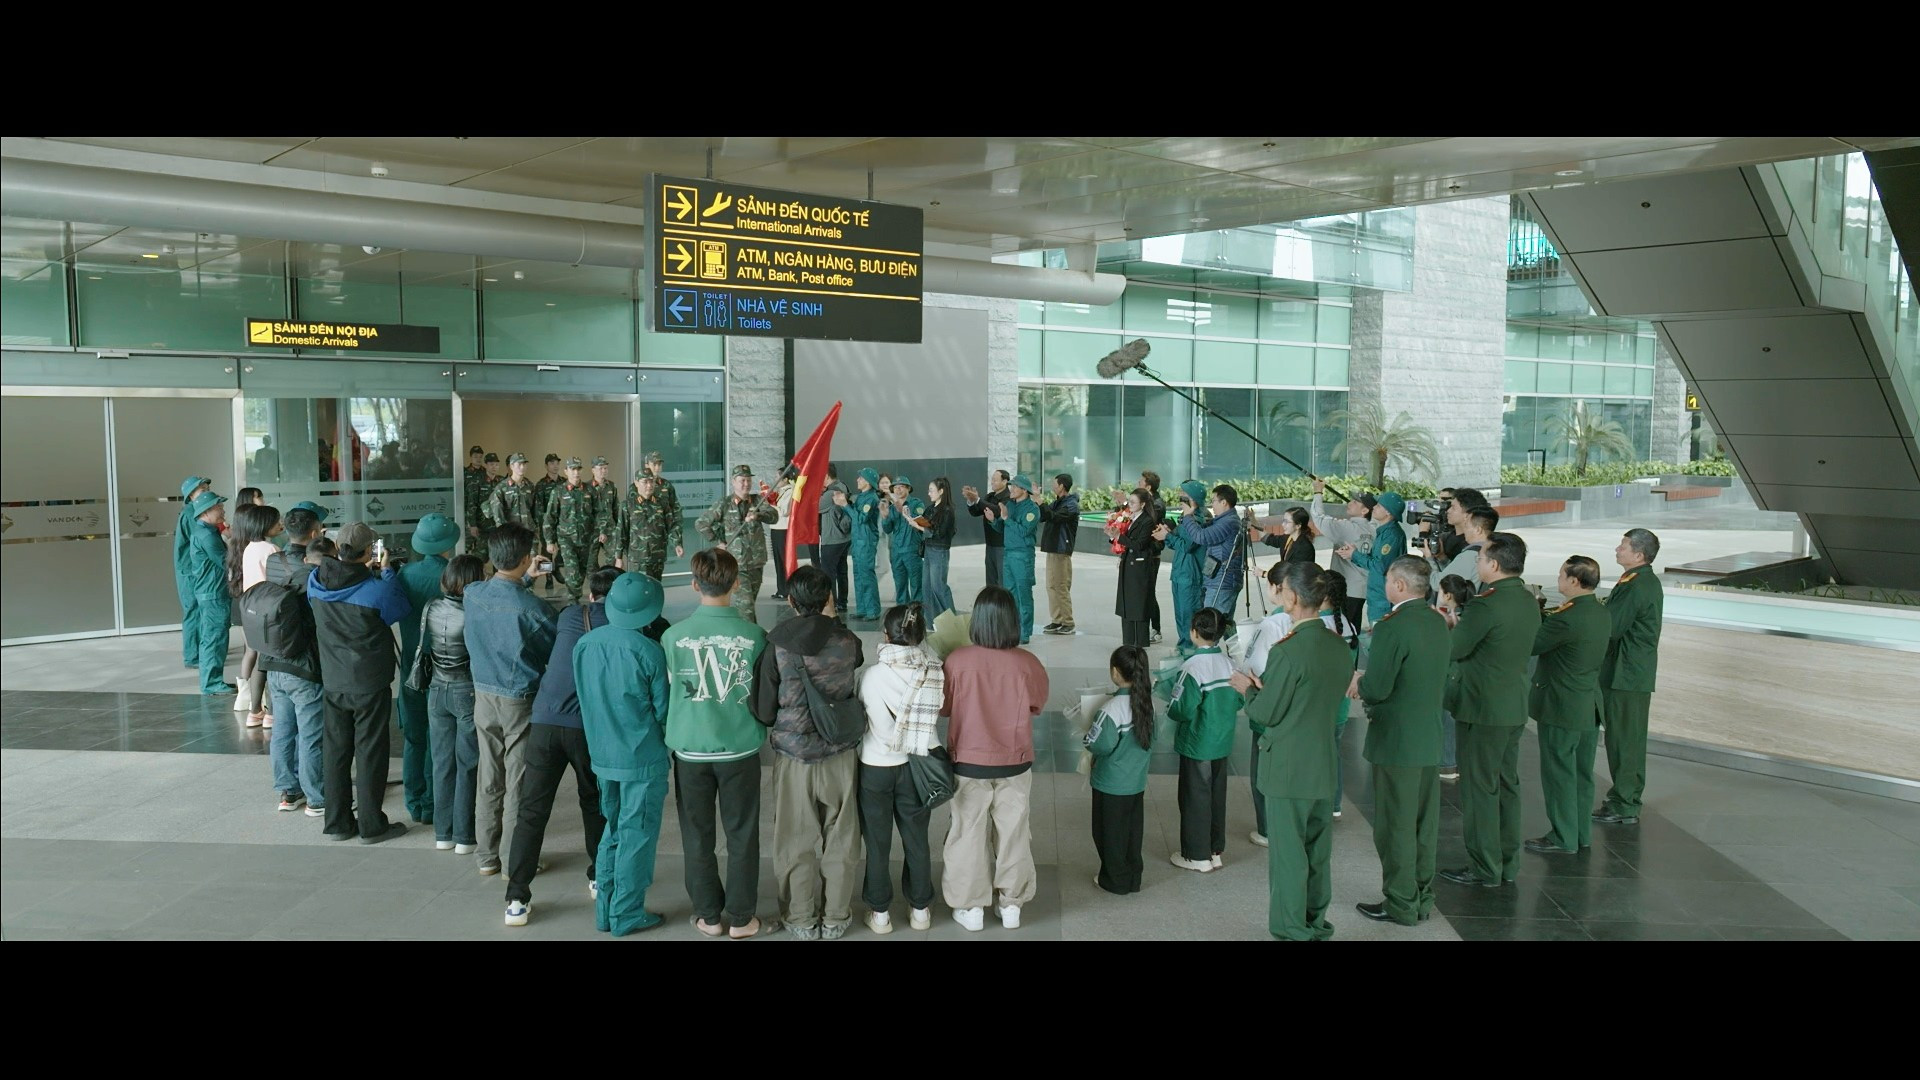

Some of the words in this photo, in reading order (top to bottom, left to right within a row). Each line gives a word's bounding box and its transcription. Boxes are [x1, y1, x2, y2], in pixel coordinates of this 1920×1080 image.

[737, 195, 776, 217] SẢNH
[779, 201, 808, 220] ĐẾN
[812, 204, 850, 225] QUỐC
[852, 209, 869, 227] TẾ
[736, 217, 803, 235] International
[804, 224, 842, 239] Arrivals
[736, 248, 771, 267] ATM,
[774, 250, 813, 268] NGÂN
[816, 253, 857, 273] HÀNG,
[888, 259, 918, 278] ĐIỆN
[736, 269, 766, 282] ATM,
[768, 270, 798, 284] Bank,
[801, 272, 825, 285] Post
[826, 274, 853, 287] office
[702, 292, 728, 300] TOILET
[736, 296, 767, 314] NHÀ
[769, 297, 788, 317] VỆ
[791, 302, 823, 316] SINH
[274, 321, 307, 334] SẢNH
[336, 325, 356, 337] NỘI
[358, 326, 378, 339] ĐỊA
[737, 316, 772, 330] Toilets
[274, 335, 321, 345] Domestic
[322, 336, 358, 347] Arrivals
